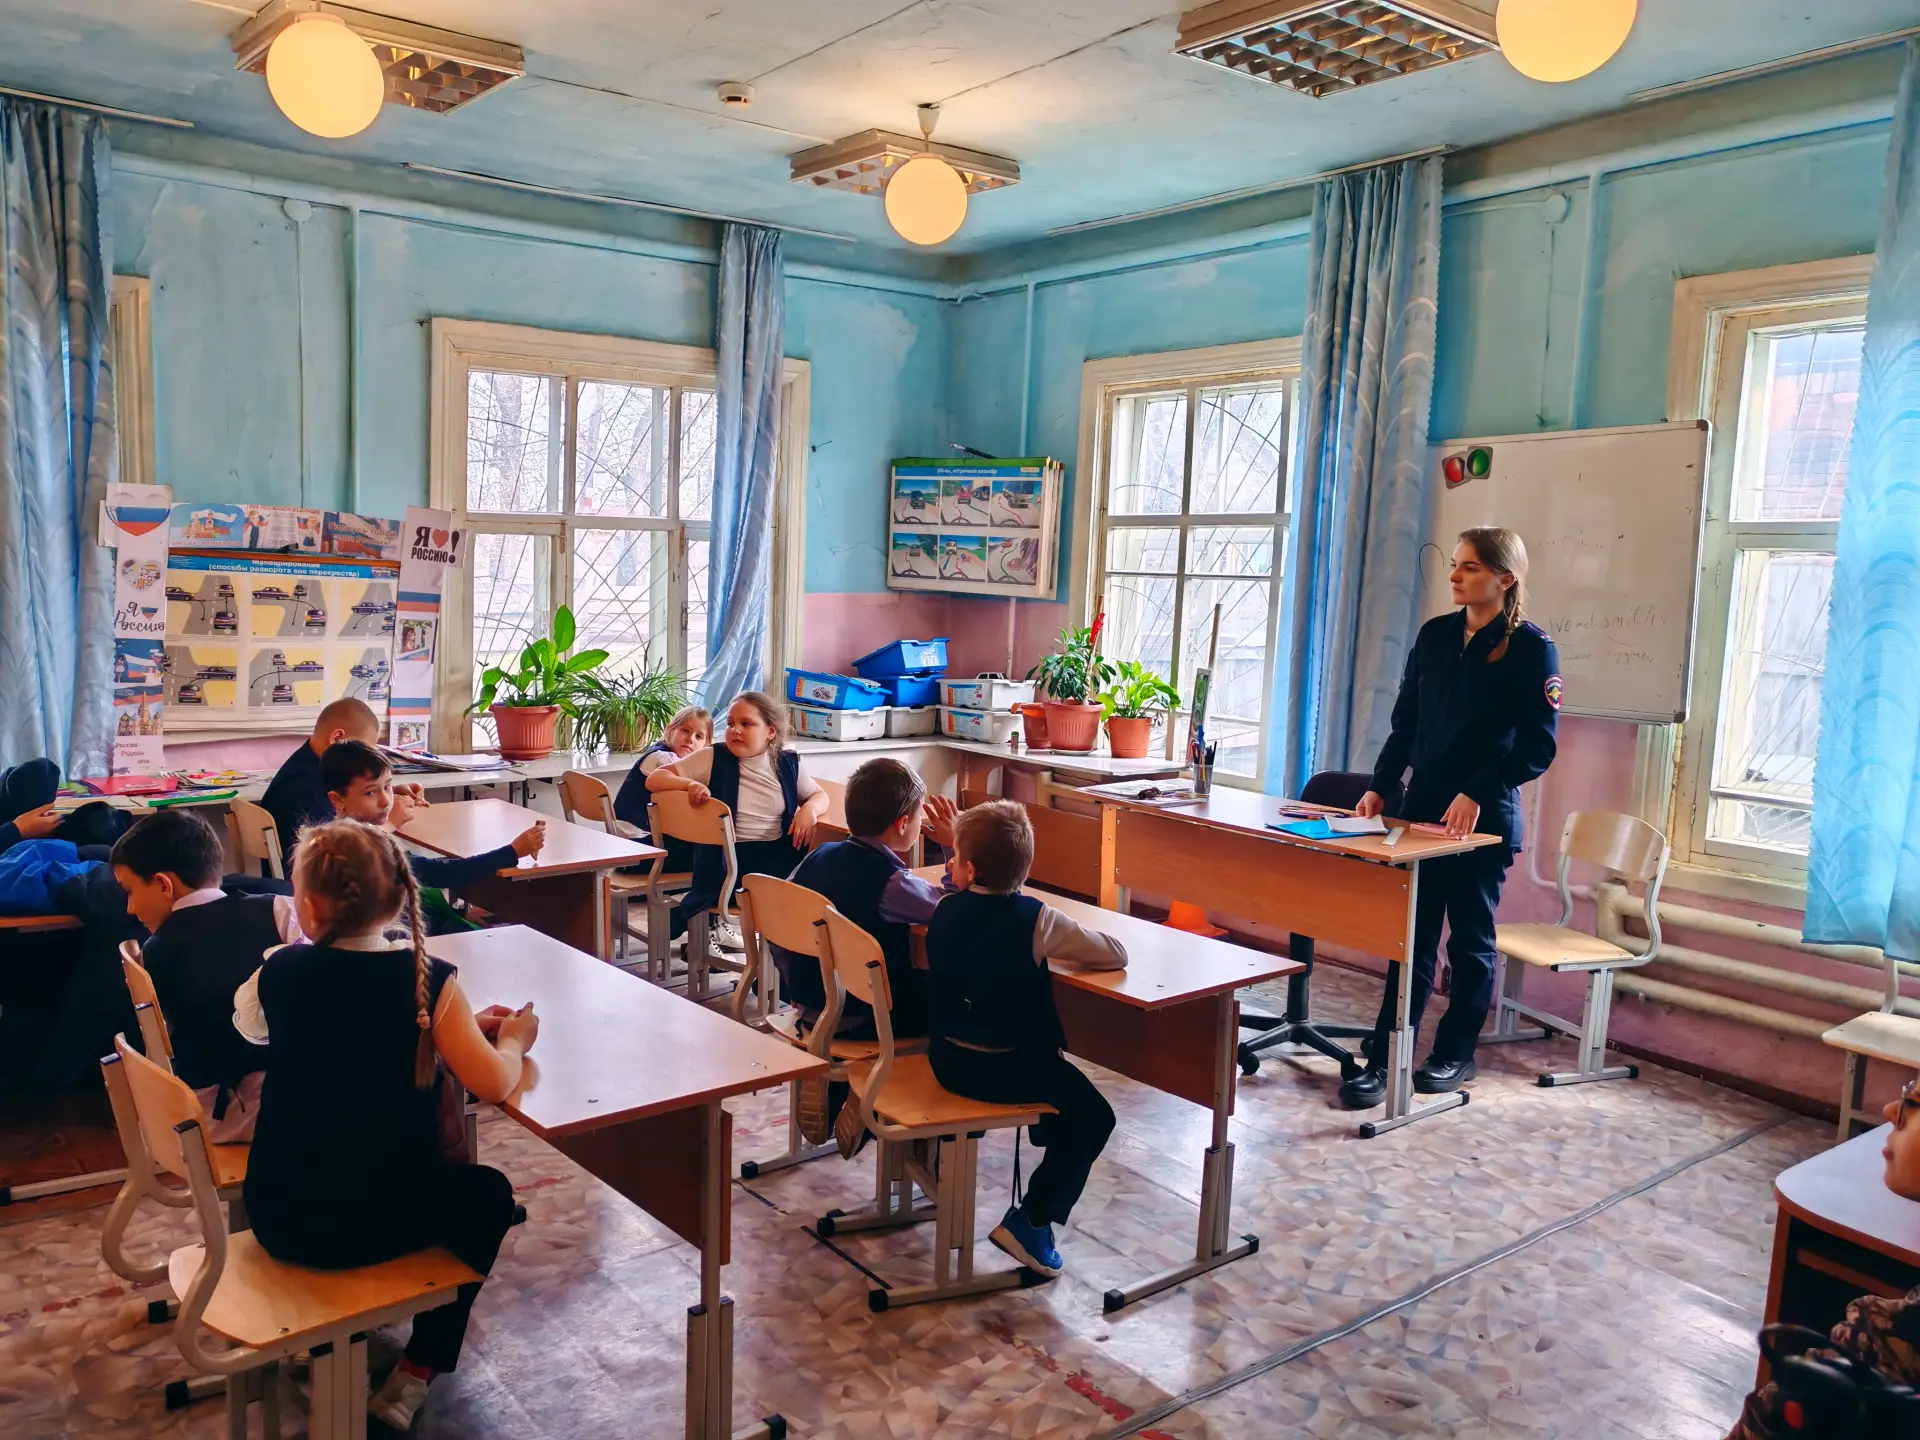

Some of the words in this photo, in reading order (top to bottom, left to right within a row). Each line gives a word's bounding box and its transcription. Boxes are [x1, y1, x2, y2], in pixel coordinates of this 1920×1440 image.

[413, 526, 431, 548] Я
[208, 563, 248, 571] (способы
[249, 566, 292, 574] разворота
[309, 569, 360, 578] перекрестка)
